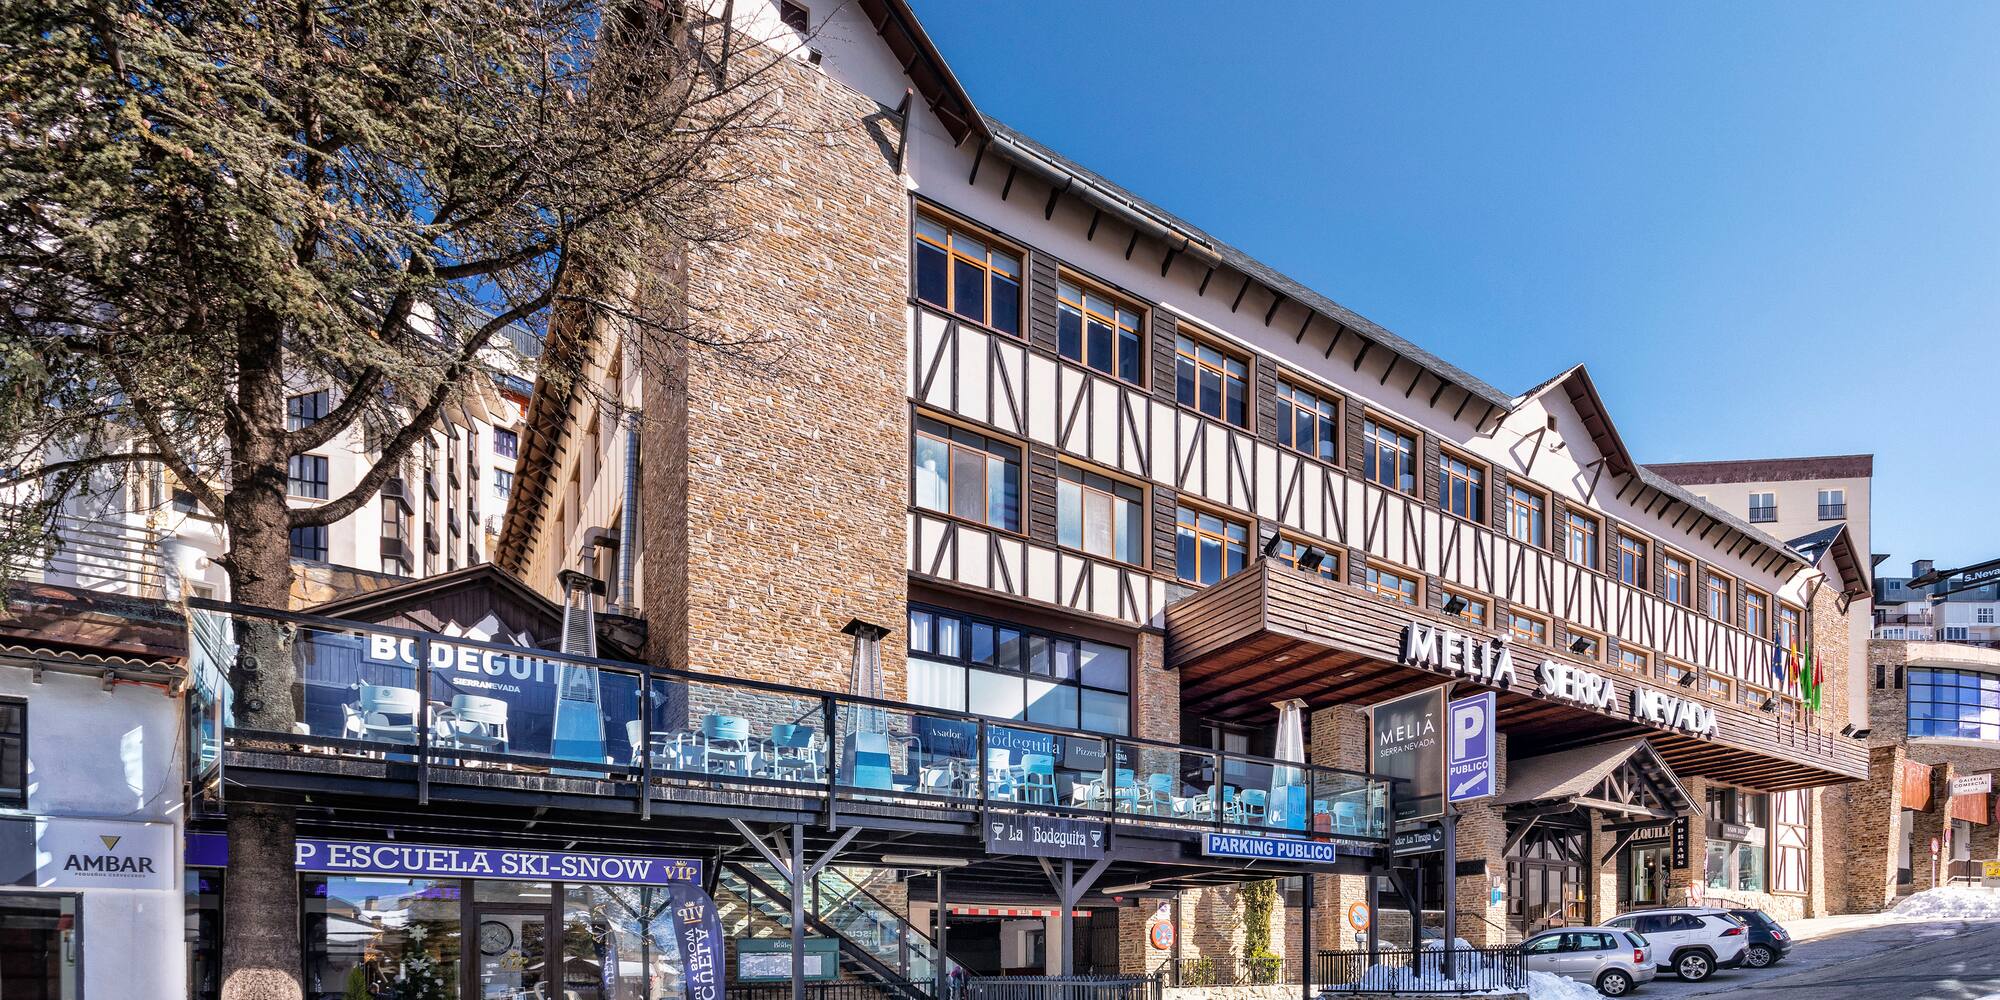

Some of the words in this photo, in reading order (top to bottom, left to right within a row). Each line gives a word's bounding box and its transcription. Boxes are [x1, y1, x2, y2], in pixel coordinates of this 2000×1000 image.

[1540, 659, 1620, 712] SIERRA
[1635, 686, 1720, 738] NEVADA
[930, 728, 962, 739] Asador
[1454, 705, 1485, 760] P
[1380, 746, 1403, 758] SIERRA
[1404, 738, 1436, 752] NEVADA
[1450, 760, 1489, 776] PUBLICO
[1954, 781, 1987, 789] COMERCIAL
[1008, 825, 1023, 841] La
[1033, 826, 1086, 849] Bodeguita
[1212, 836, 1274, 856] PARKING
[1277, 842, 1332, 860] PUBLICO
[63, 854, 157, 874] AMBAR
[326, 844, 494, 873] ESCUELA
[501, 853, 653, 880] SKI-SNOW
[663, 865, 698, 881] VIP
